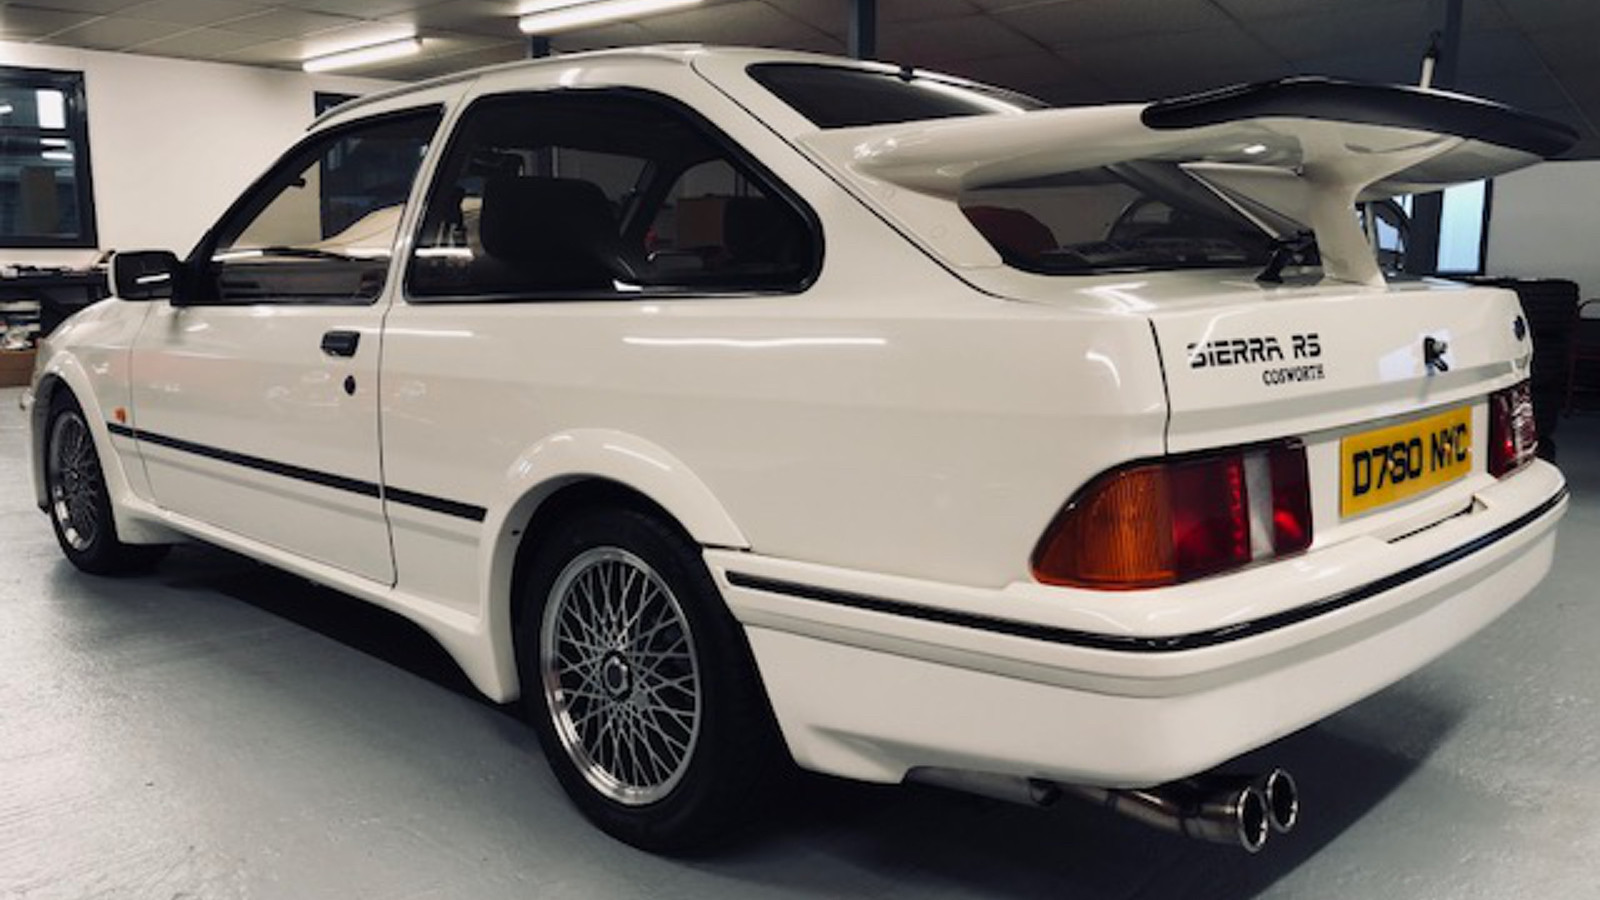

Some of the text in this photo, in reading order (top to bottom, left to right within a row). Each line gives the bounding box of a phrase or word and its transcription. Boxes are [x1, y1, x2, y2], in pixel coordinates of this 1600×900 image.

[1187, 333, 1321, 368] SIERRA RS
[1262, 364, 1325, 386] COSWORTH
